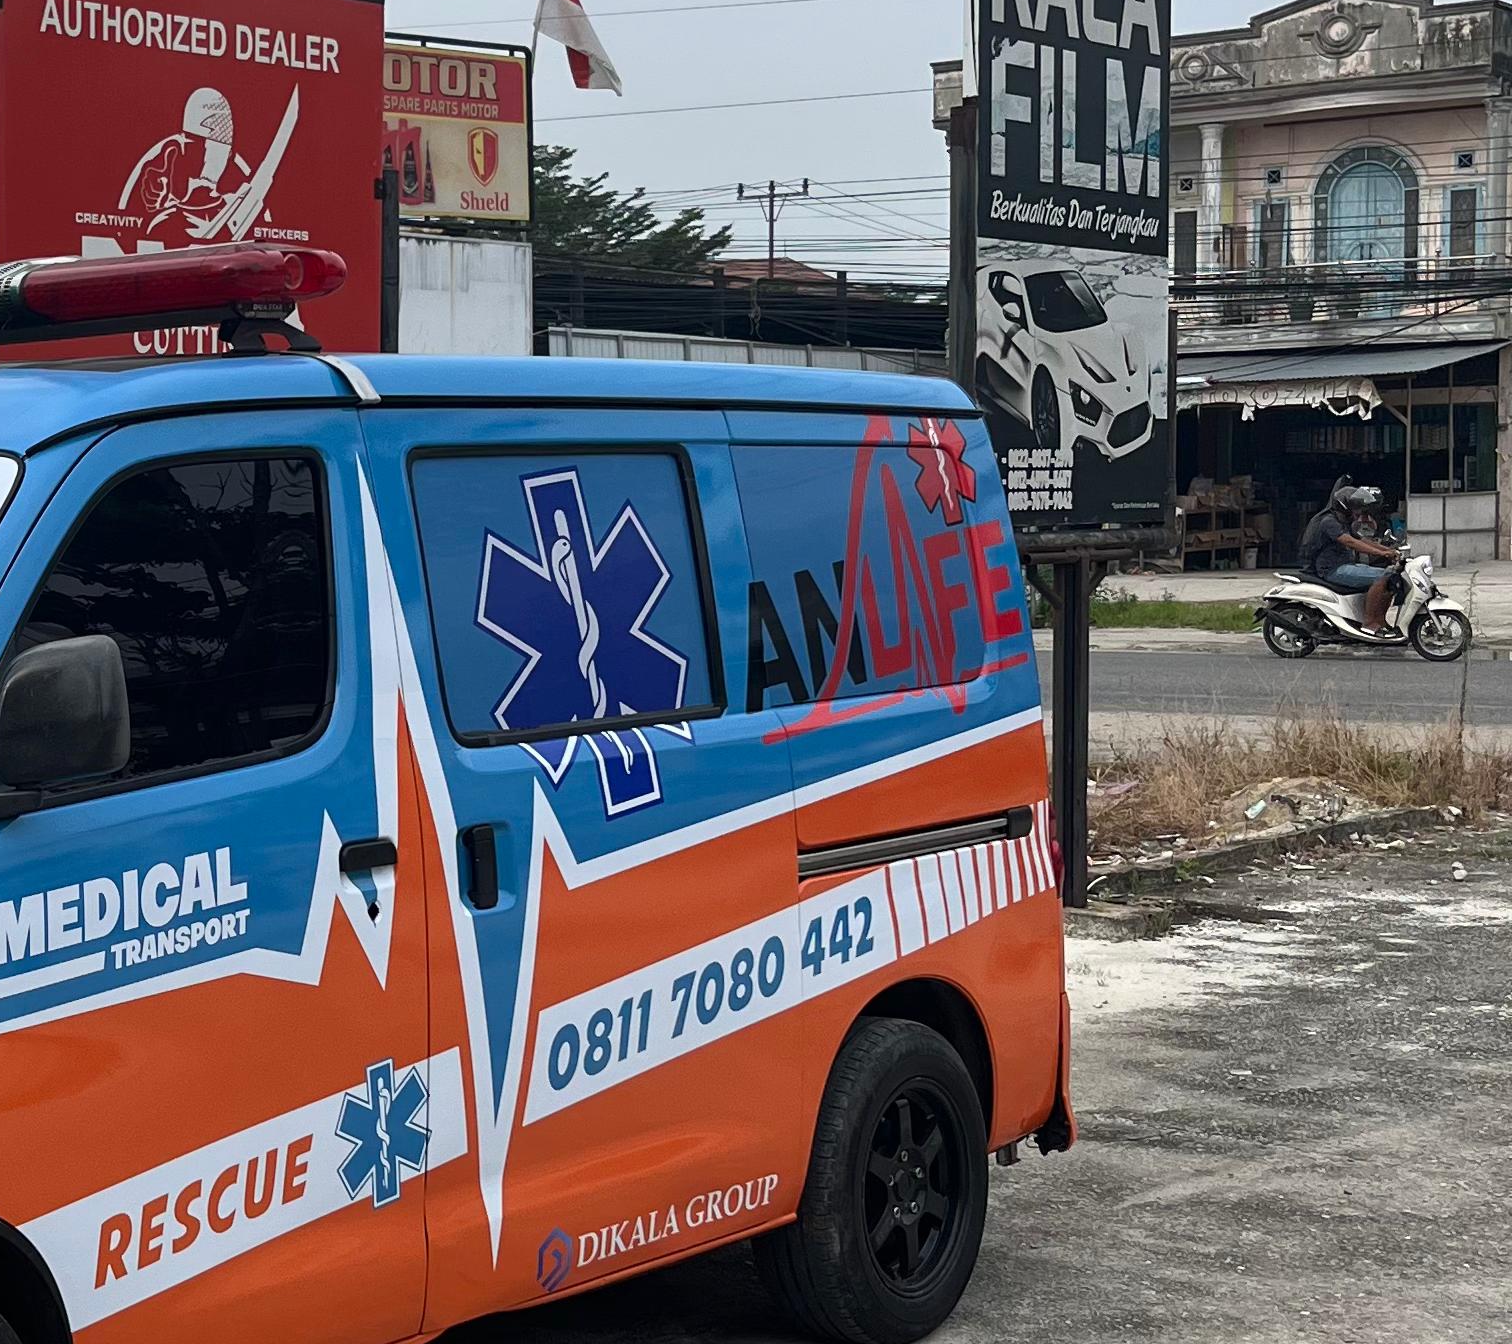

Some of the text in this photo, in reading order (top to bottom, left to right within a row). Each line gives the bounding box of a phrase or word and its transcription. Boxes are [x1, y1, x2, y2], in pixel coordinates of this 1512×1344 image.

[235, 24, 340, 74] DEALER
[382, 53, 497, 100] OTOR
[383, 96, 499, 120] SPARE PARTS MOTOR
[991, 36, 1161, 198] FILM
[75, 212, 143, 229] CREATIVITY
[460, 191, 509, 212] Shield
[990, 190, 1160, 244] Berkualitas Dan Terjangkau
[254, 227, 309, 241] STICKERS
[110, 908, 250, 969] TRANSPORT
[548, 896, 875, 1091] 0811 7080 442
[94, 1133, 314, 1290] RESCUE
[577, 1174, 779, 1268] DIKALA GROUP
